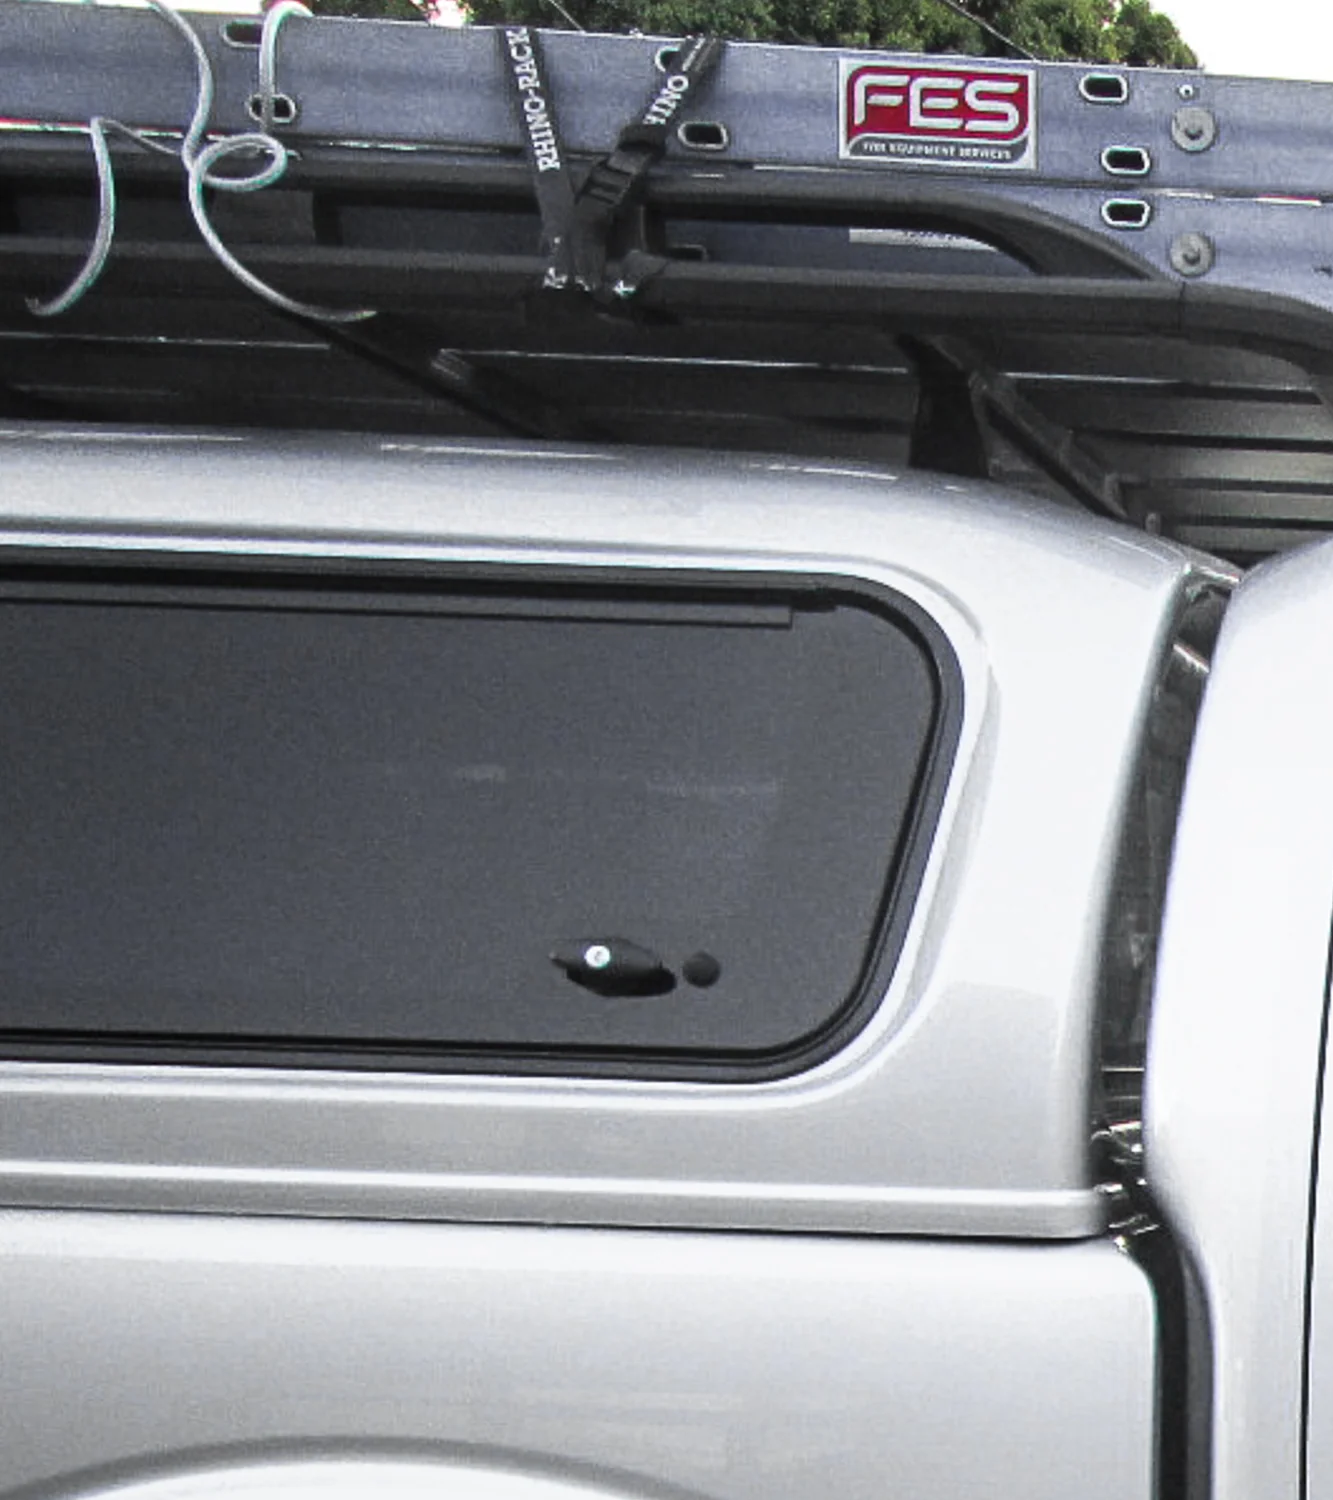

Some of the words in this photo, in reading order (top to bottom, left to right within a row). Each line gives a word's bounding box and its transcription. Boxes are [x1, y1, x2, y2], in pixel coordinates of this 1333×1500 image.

[505, 27, 561, 173] RHINO-RACK
[853, 73, 1022, 133] FES
[889, 143, 956, 157] EQUIPMENT
[959, 147, 1012, 160] SERVICES
